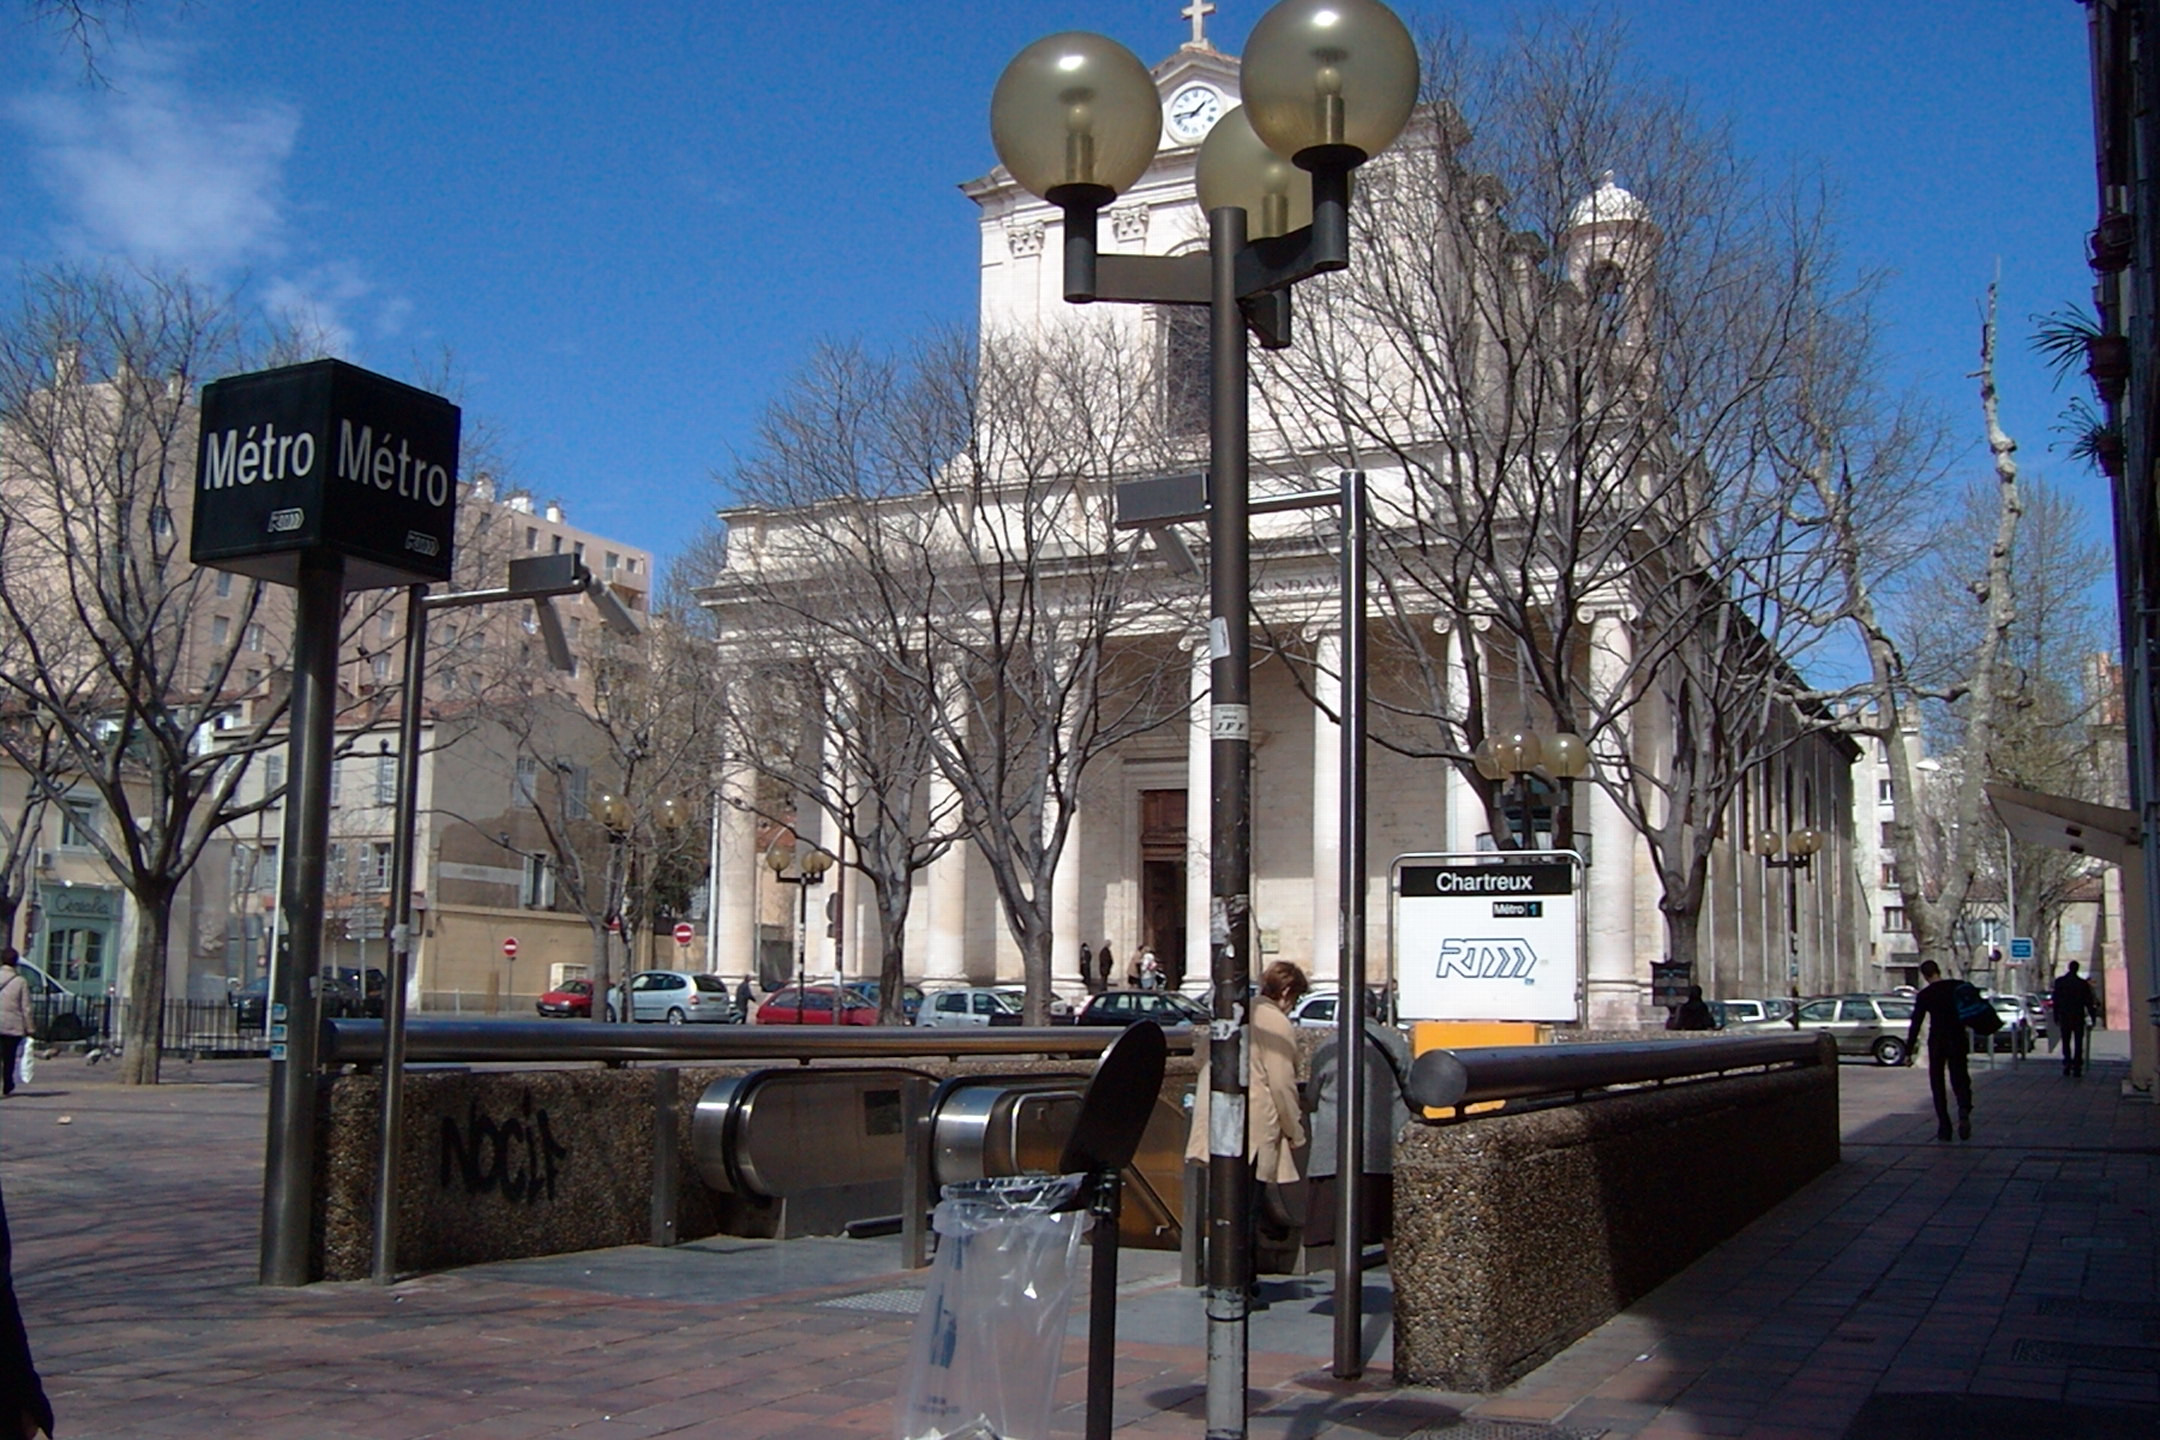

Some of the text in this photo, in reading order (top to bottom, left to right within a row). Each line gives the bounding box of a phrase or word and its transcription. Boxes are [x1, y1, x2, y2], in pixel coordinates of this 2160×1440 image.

[203, 423, 315, 490] Métro
[338, 418, 448, 507] Métro
[1436, 872, 1533, 891] Chartreux
[1494, 903, 1537, 916] Métro 1
